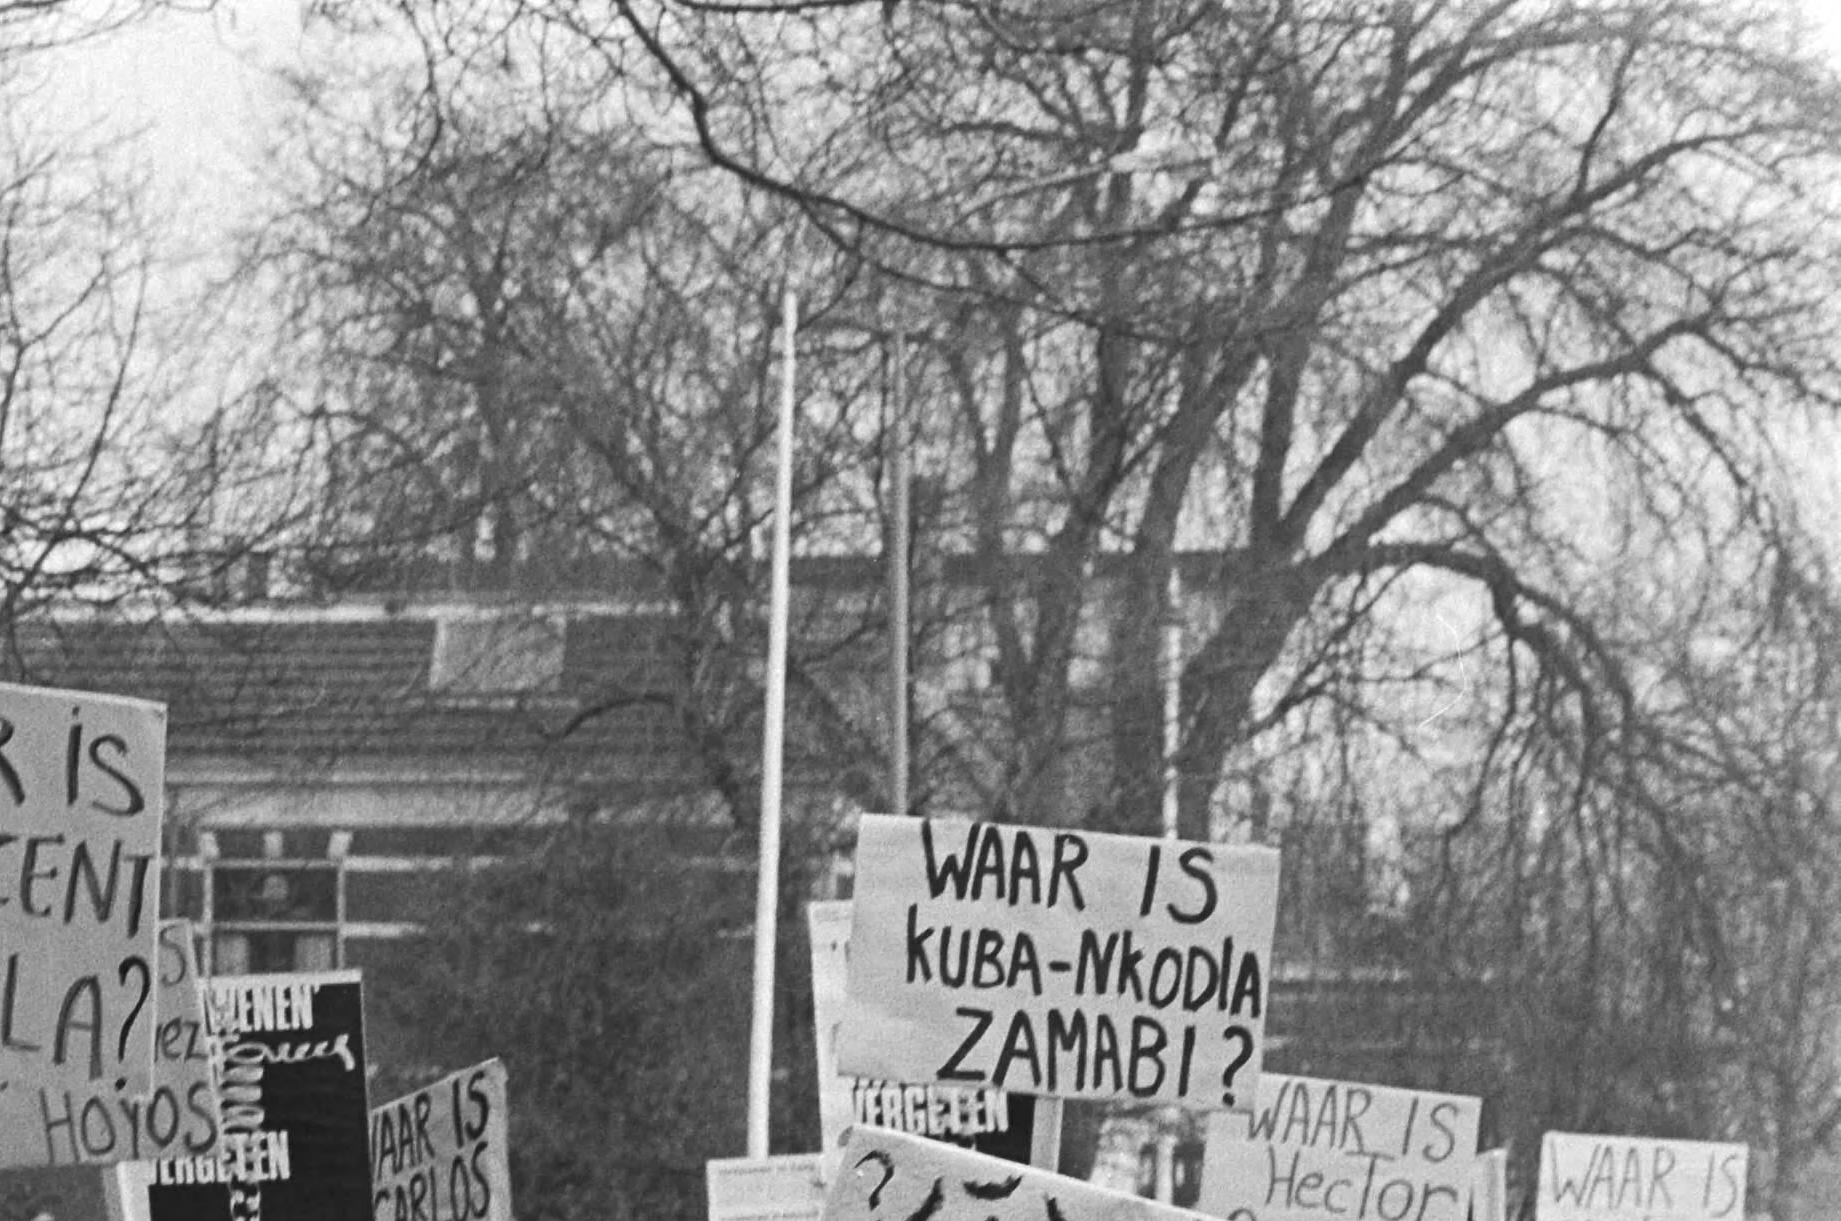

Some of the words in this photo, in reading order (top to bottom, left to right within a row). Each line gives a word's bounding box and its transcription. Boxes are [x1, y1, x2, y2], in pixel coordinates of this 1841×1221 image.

[921, 818, 1090, 912] WAAR
[1140, 844, 1218, 925] IS
[905, 903, 1261, 1019] KUBA-NKODIA
[39, 1081, 219, 1164] HOYOS
[452, 1070, 489, 1149] IS
[1248, 1080, 1372, 1154] WAAR
[1403, 1097, 1458, 1163] IS
[1549, 1137, 1675, 1210] WAAR
[1702, 1150, 1739, 1219] IS
